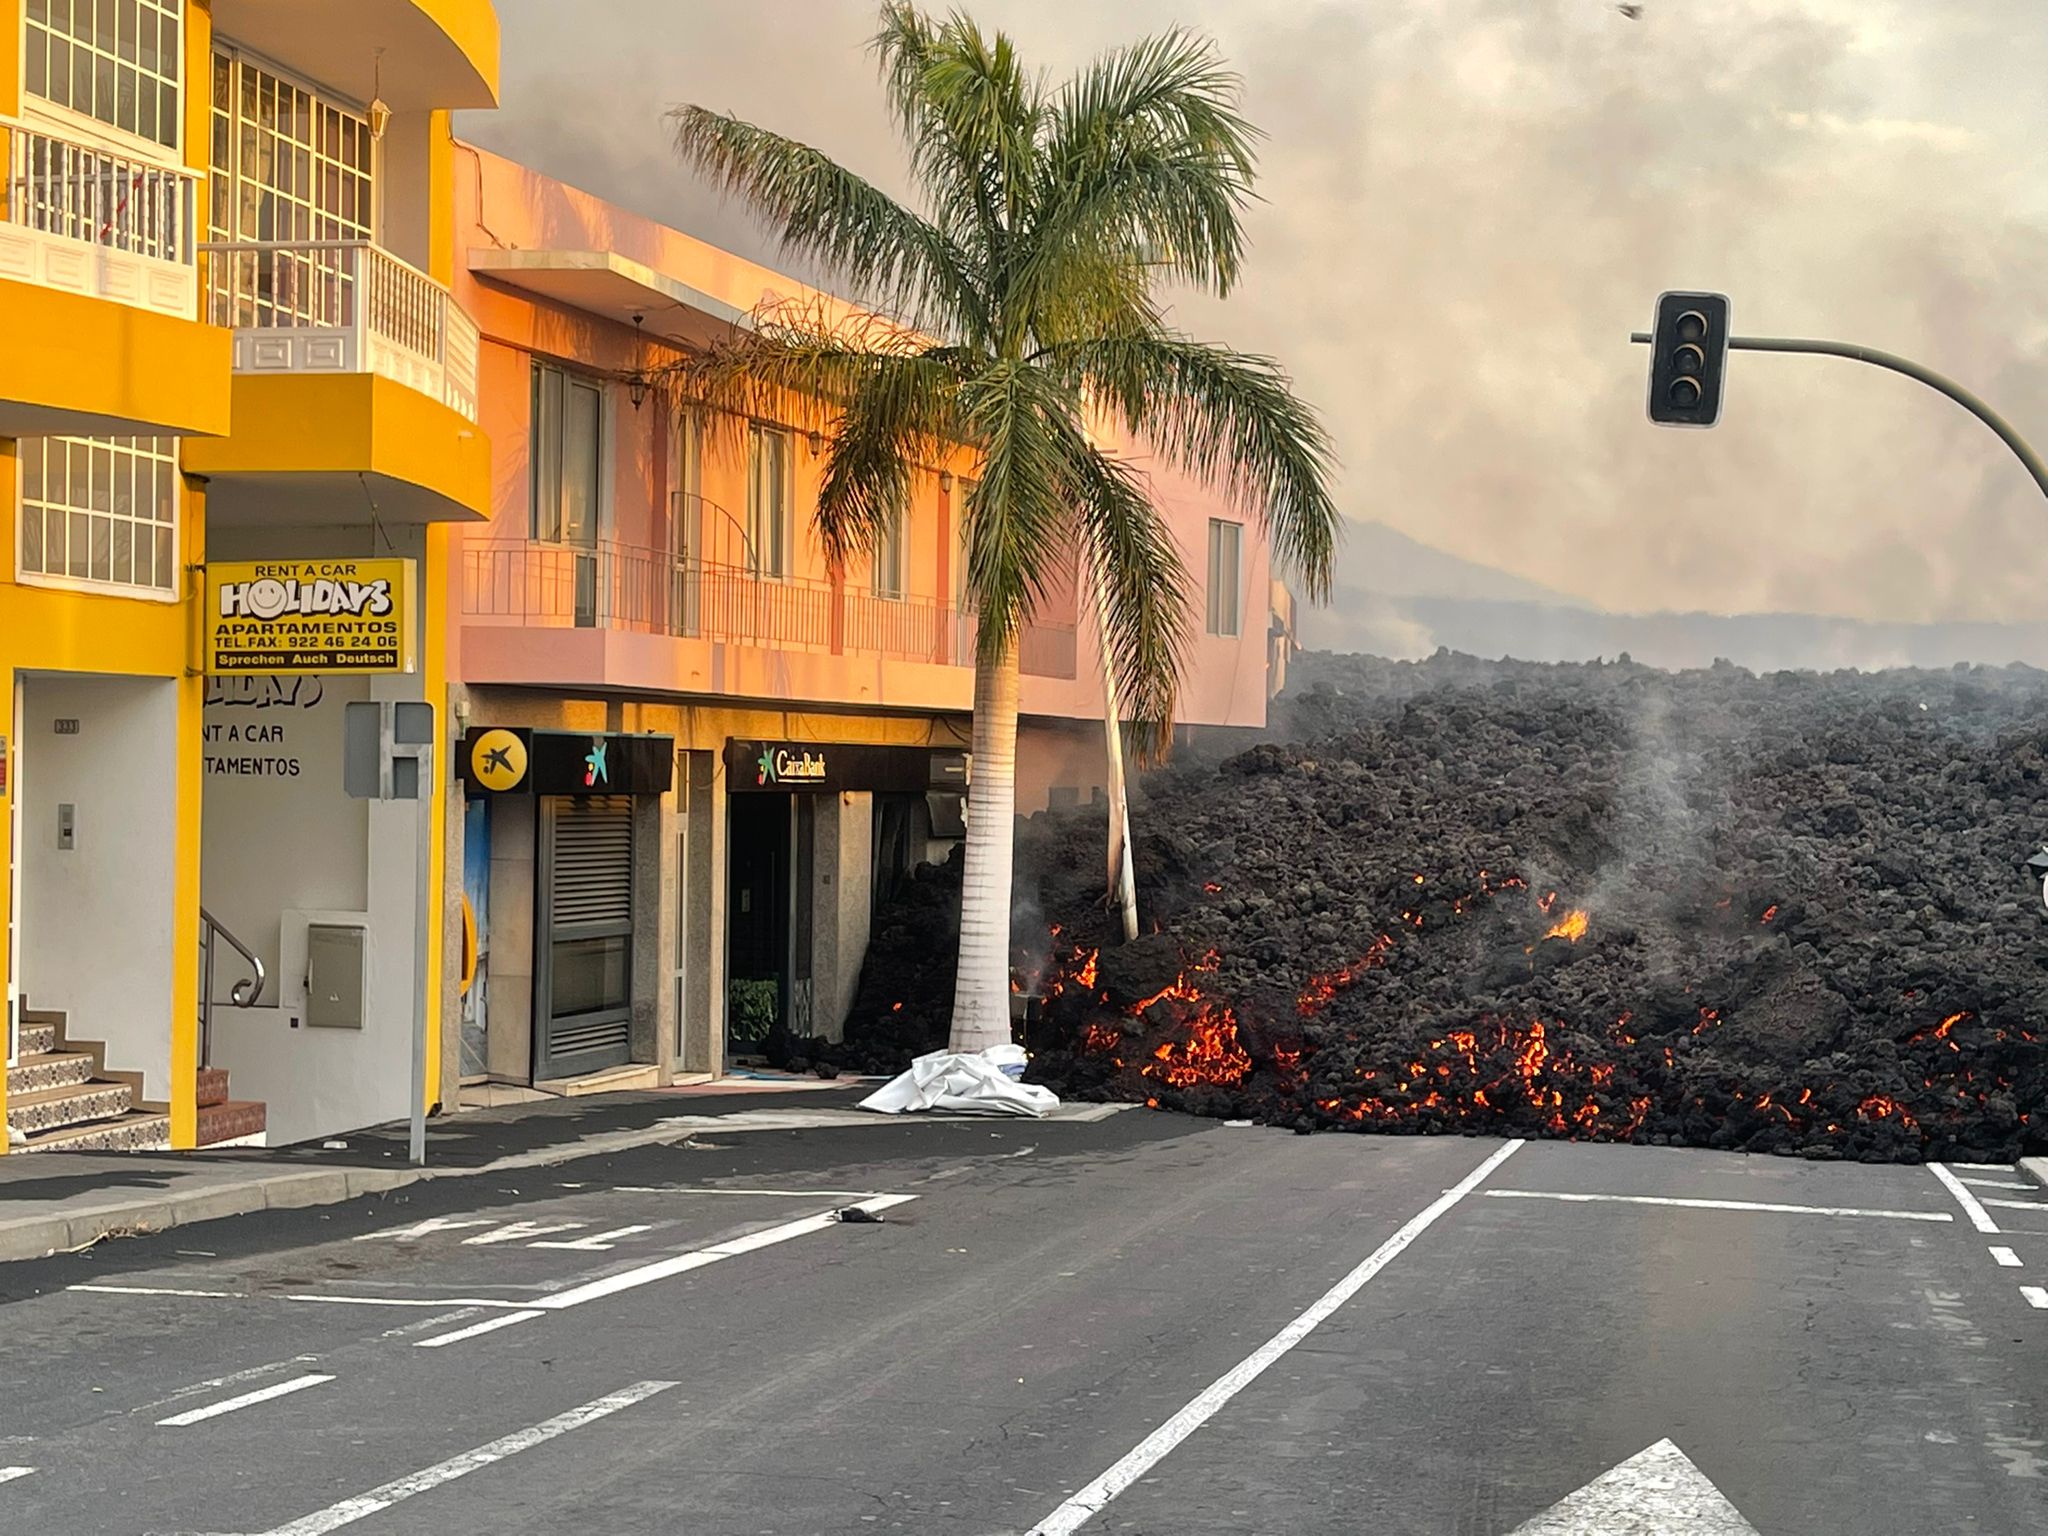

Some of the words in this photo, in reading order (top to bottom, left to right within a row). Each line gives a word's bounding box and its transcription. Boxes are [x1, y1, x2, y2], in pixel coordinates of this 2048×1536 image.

[255, 565, 299, 576] RENT
[304, 565, 316, 576] A
[320, 565, 357, 576] CAR
[220, 578, 393, 621] HOLIDAYS
[215, 622, 397, 635] APARTAMENTOS
[288, 636, 318, 648] 922
[324, 636, 345, 648] 46
[350, 636, 371, 647] 24
[377, 636, 397, 647] 06
[218, 654, 285, 666] Sprechen
[291, 653, 328, 664] Auch
[335, 653, 395, 664] Deutsch
[228, 724, 239, 742] A
[244, 724, 284, 742] CAR
[204, 757, 300, 776] TAMENTOS
[776, 750, 826, 777] CaixaBank
